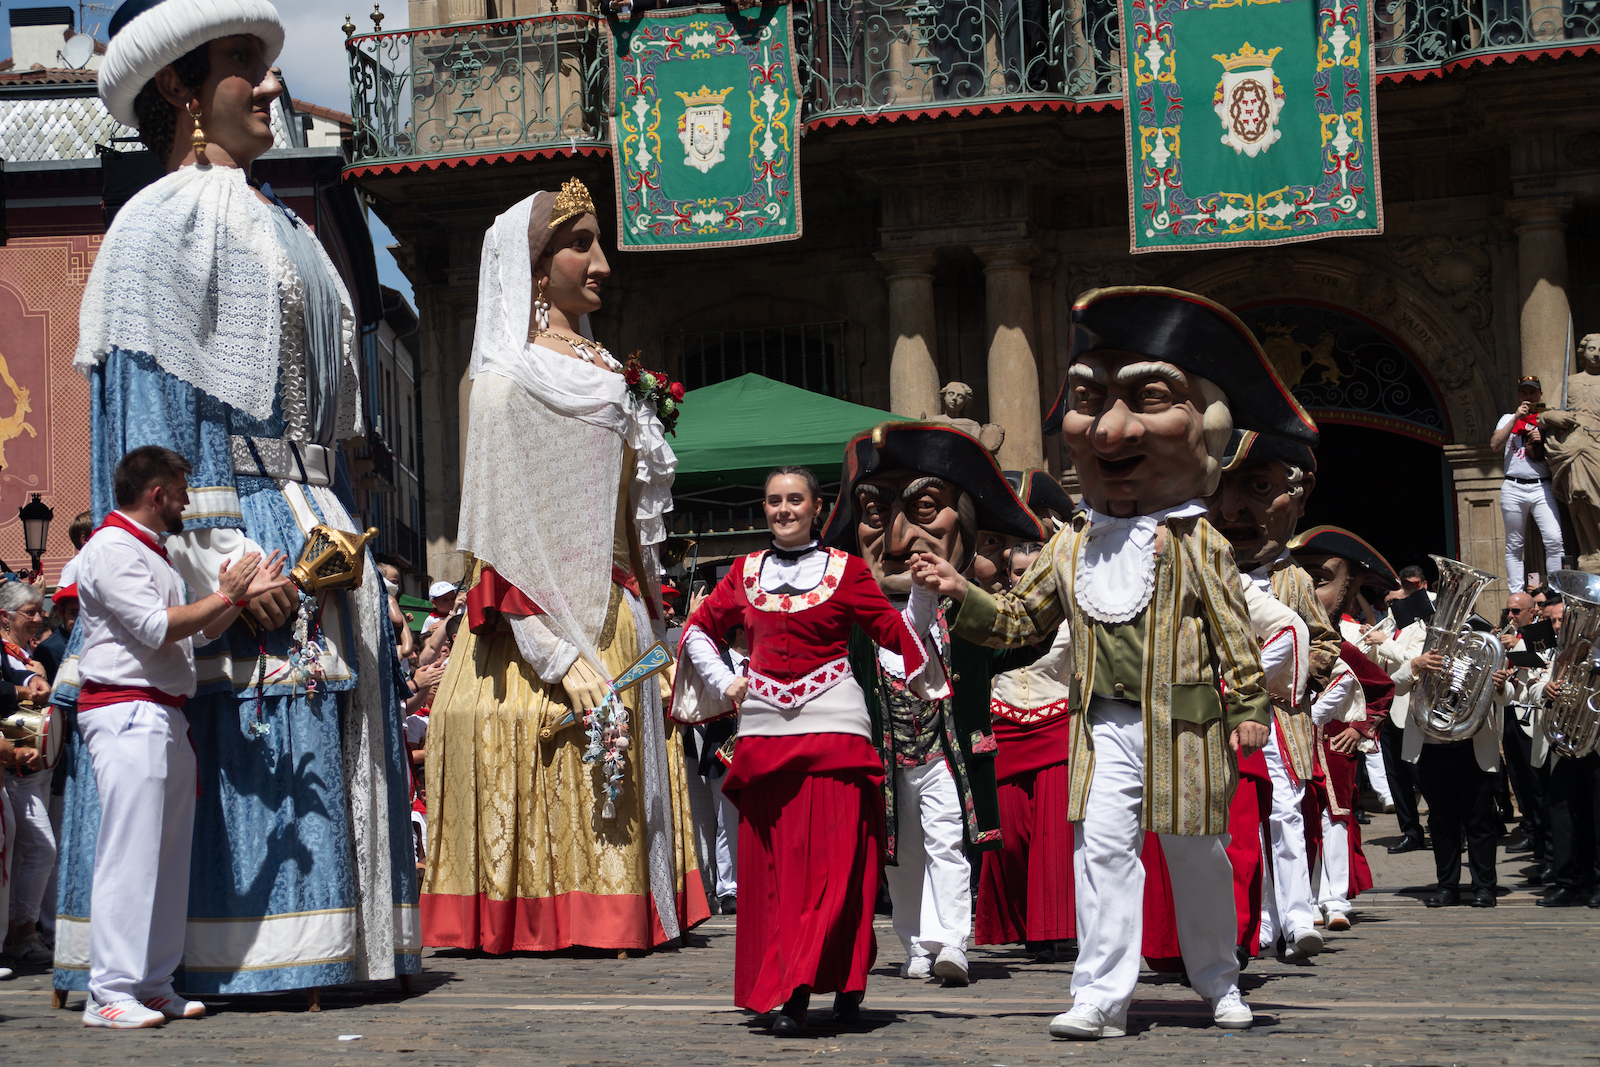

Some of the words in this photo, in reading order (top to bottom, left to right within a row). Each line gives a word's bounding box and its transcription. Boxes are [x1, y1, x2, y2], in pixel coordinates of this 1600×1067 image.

[1312, 273, 1340, 288] COR
[1401, 312, 1435, 346] VALDE
[1458, 394, 1477, 436] MAGIS
